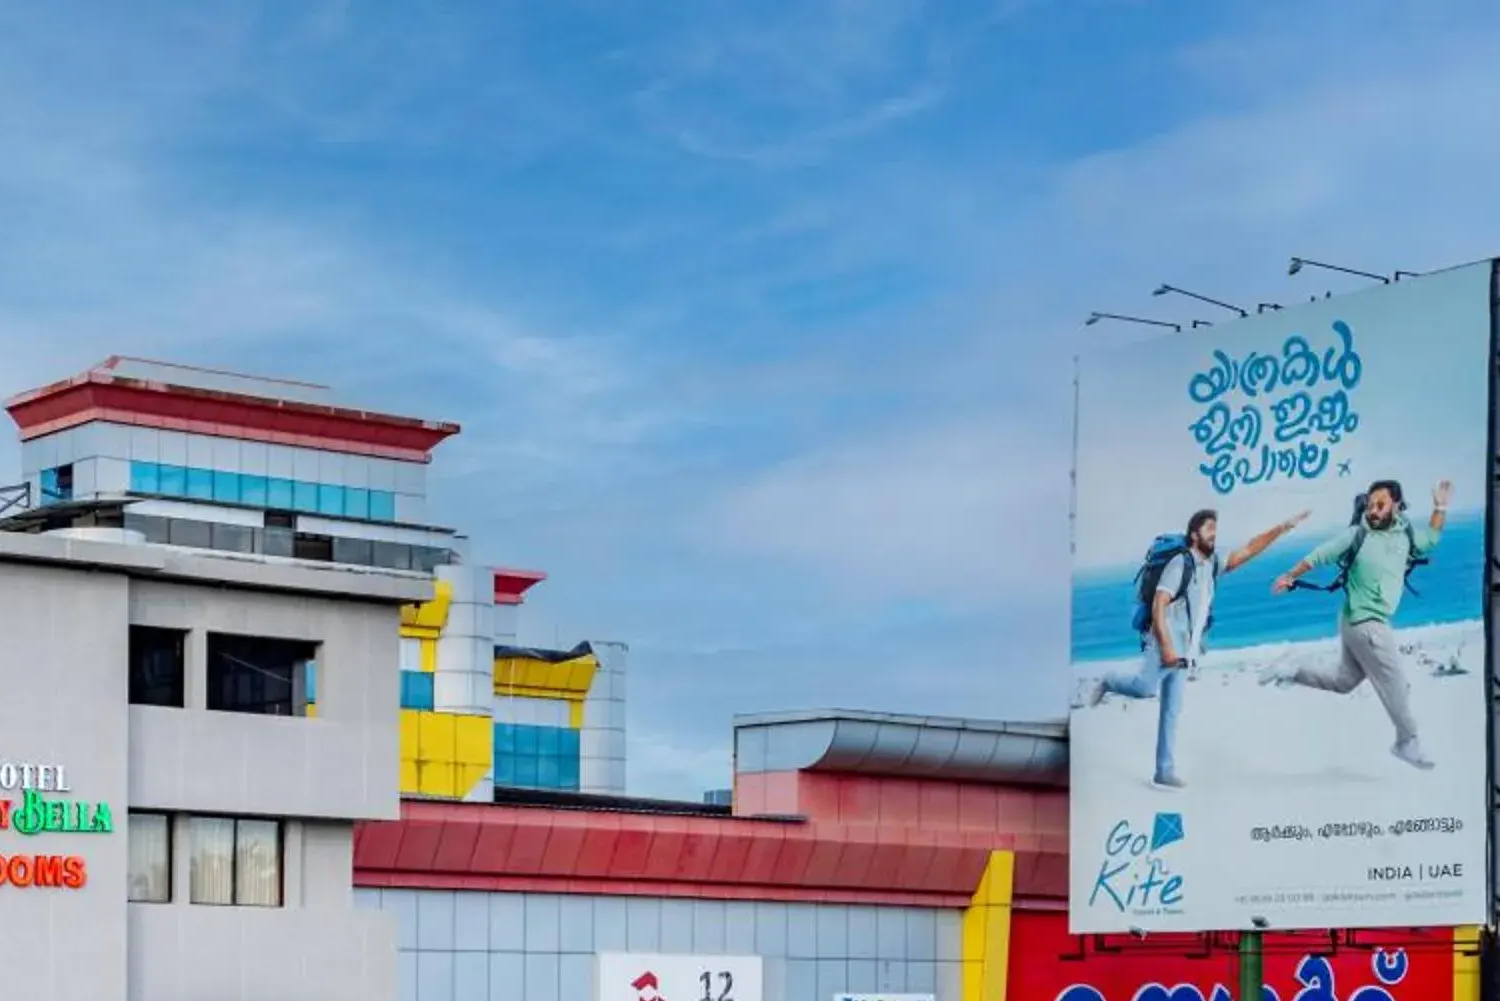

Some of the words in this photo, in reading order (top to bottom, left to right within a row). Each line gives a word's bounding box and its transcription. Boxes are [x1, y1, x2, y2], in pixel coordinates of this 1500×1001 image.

[1106, 819, 1148, 857] Go
[1089, 859, 1184, 912] Kite
[1367, 866, 1413, 881] INDIA
[1428, 863, 1463, 878] UAE
